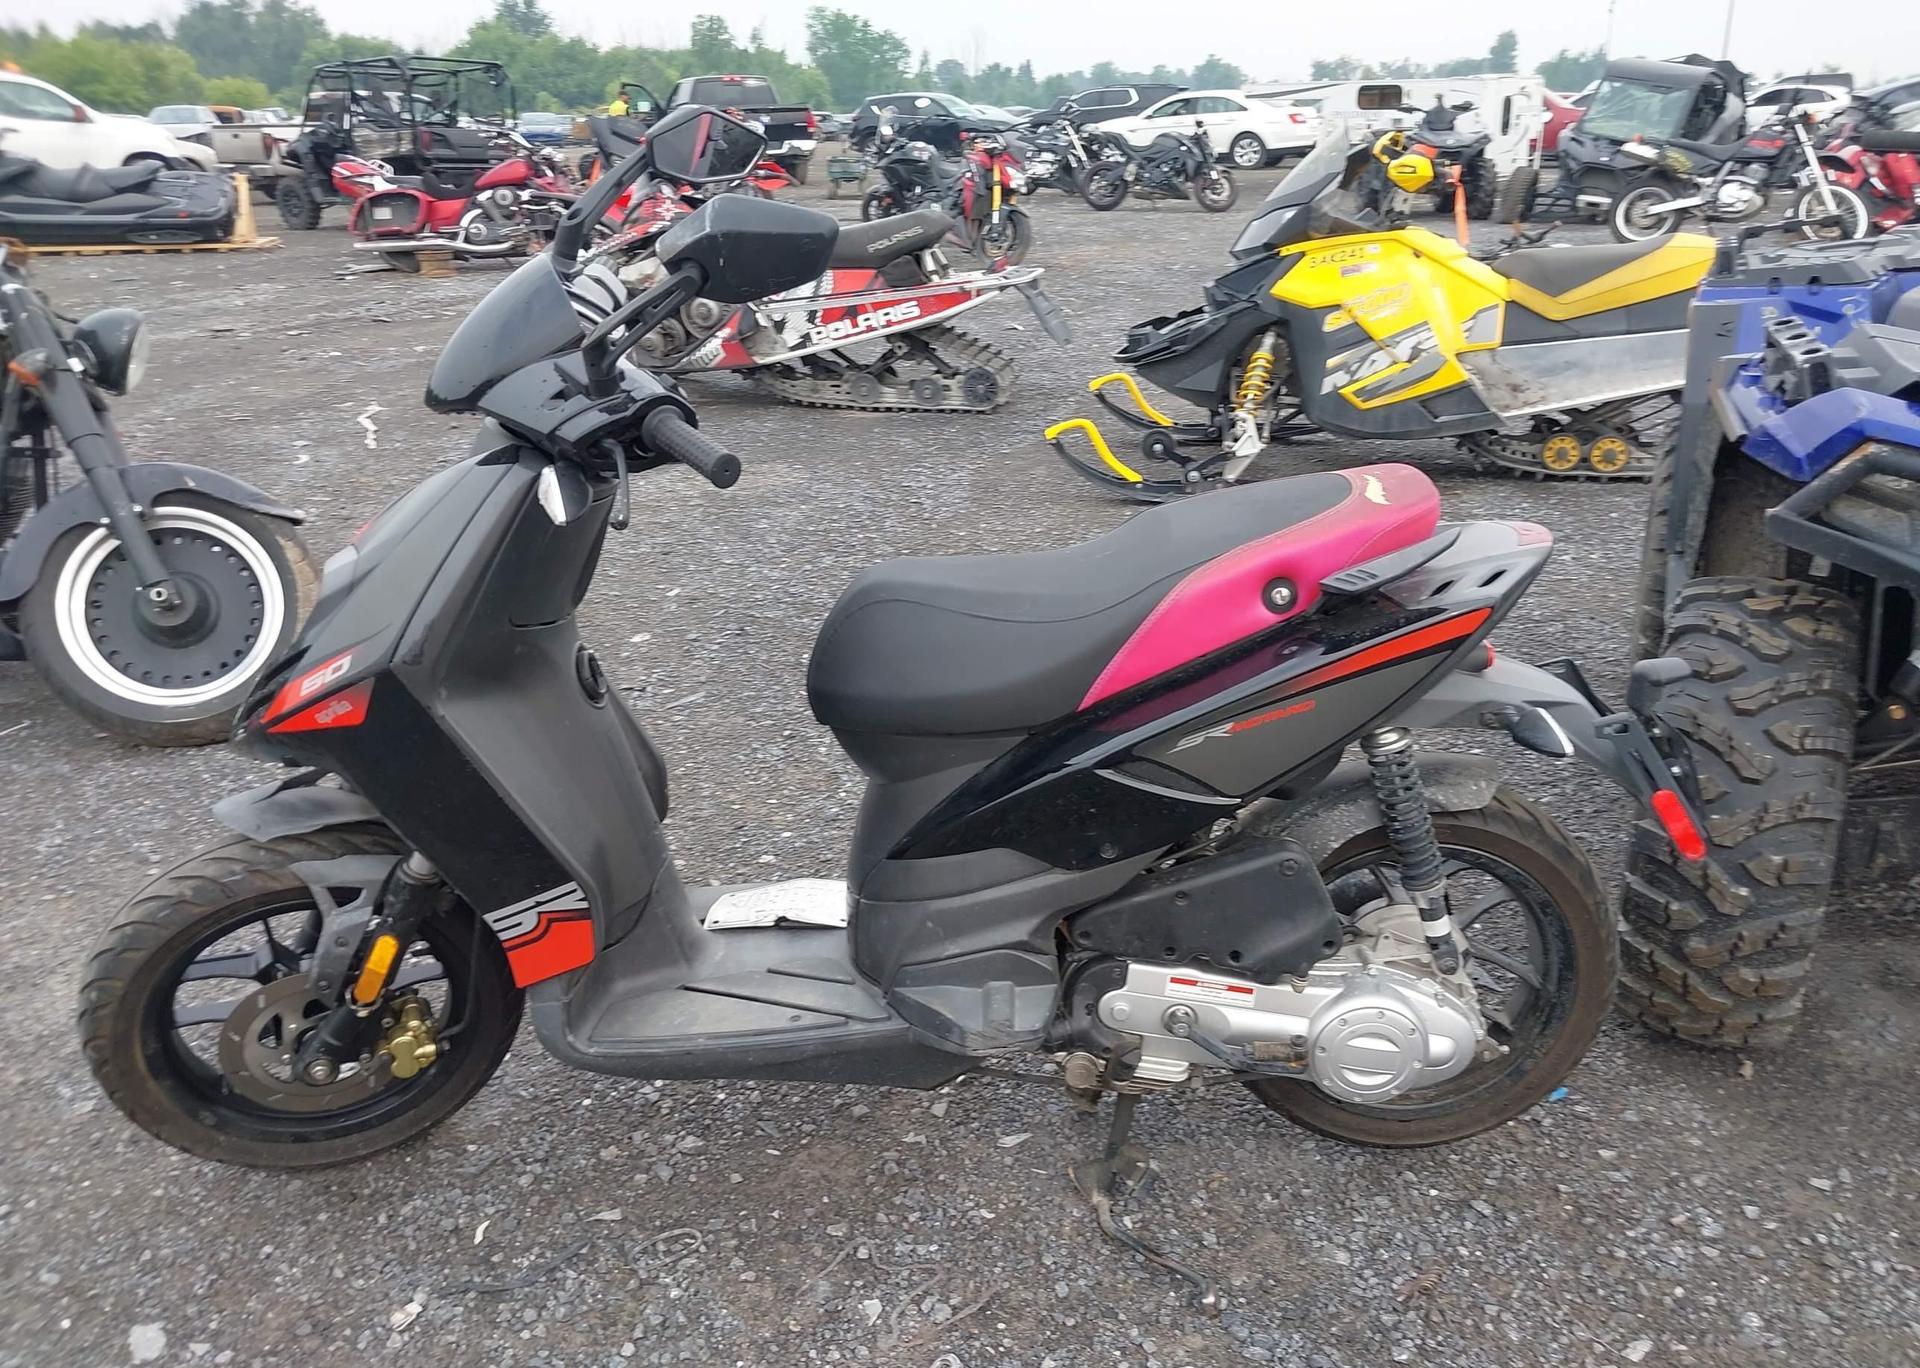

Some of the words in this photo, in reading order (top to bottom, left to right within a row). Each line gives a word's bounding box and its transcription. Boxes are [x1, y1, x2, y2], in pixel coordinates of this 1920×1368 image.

[866, 225, 925, 254] POLARIS
[809, 300, 921, 344] POLARIS
[299, 654, 353, 697] 50
